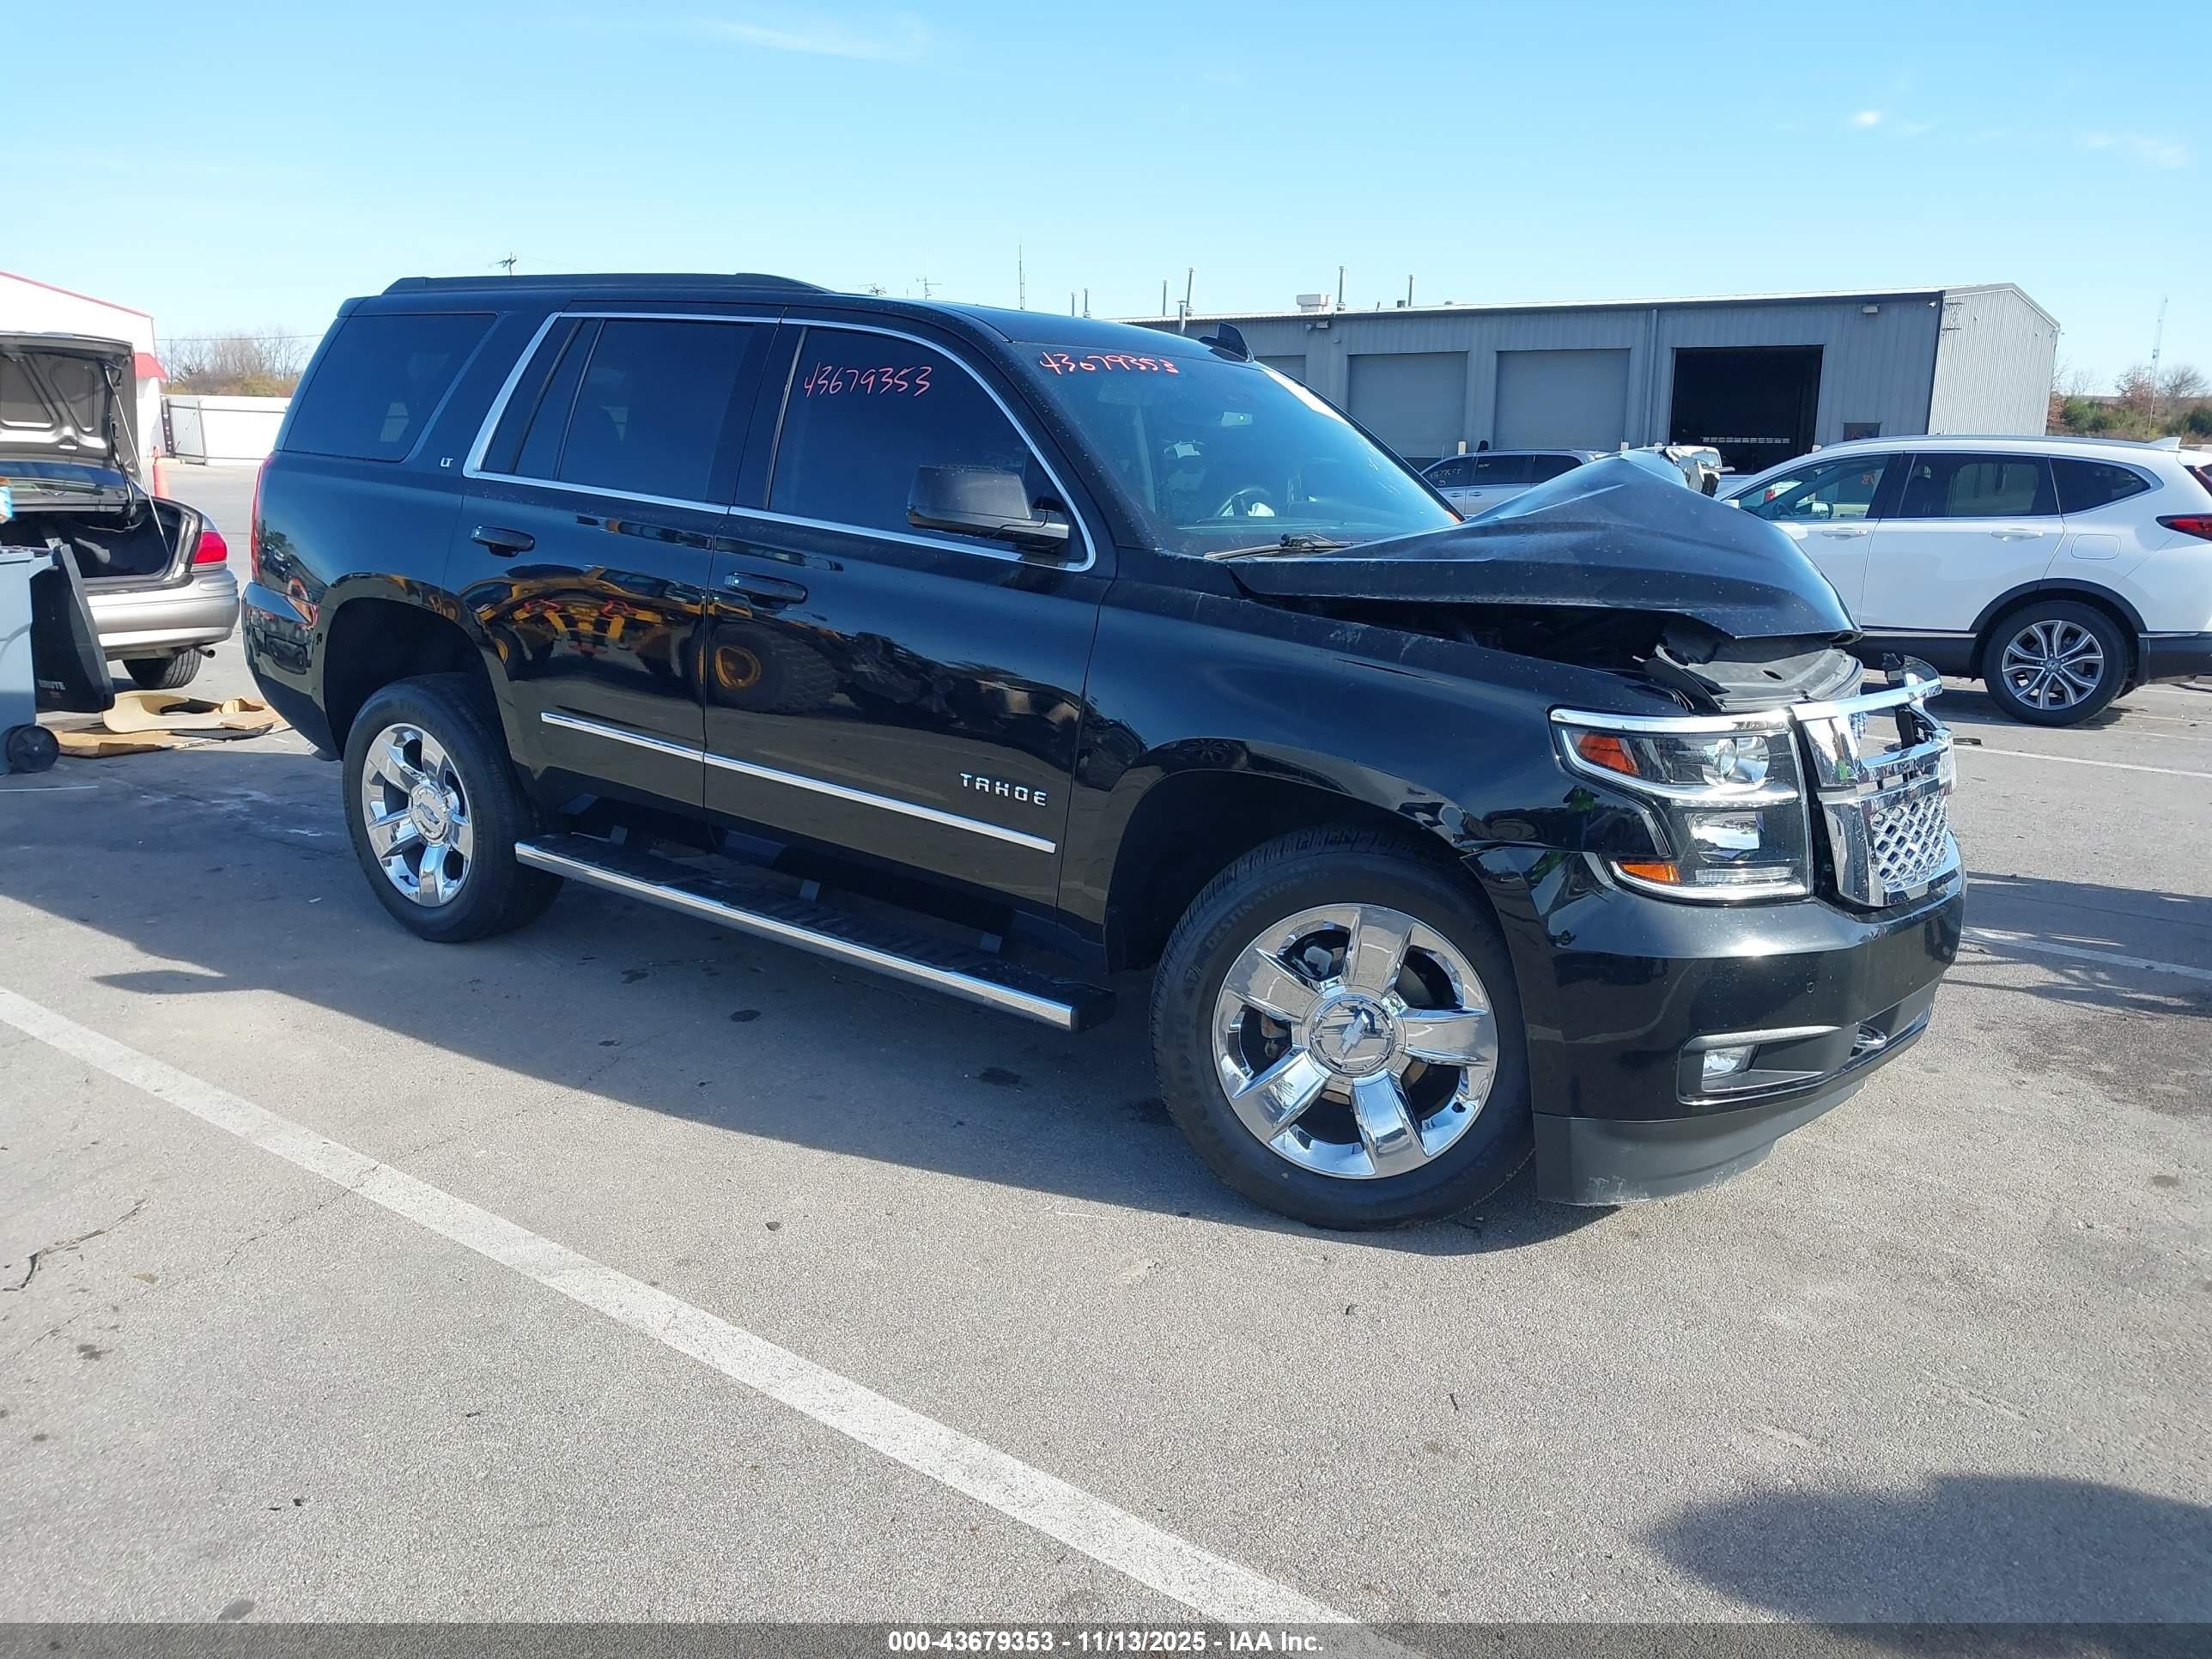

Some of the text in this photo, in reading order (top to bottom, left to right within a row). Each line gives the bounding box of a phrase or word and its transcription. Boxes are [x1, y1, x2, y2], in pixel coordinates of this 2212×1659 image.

[804, 362, 933, 398] 43679353
[440, 457, 453, 468] LT
[960, 773, 1048, 806] TAHOE
[1205, 878, 1304, 949] DESTINATION
